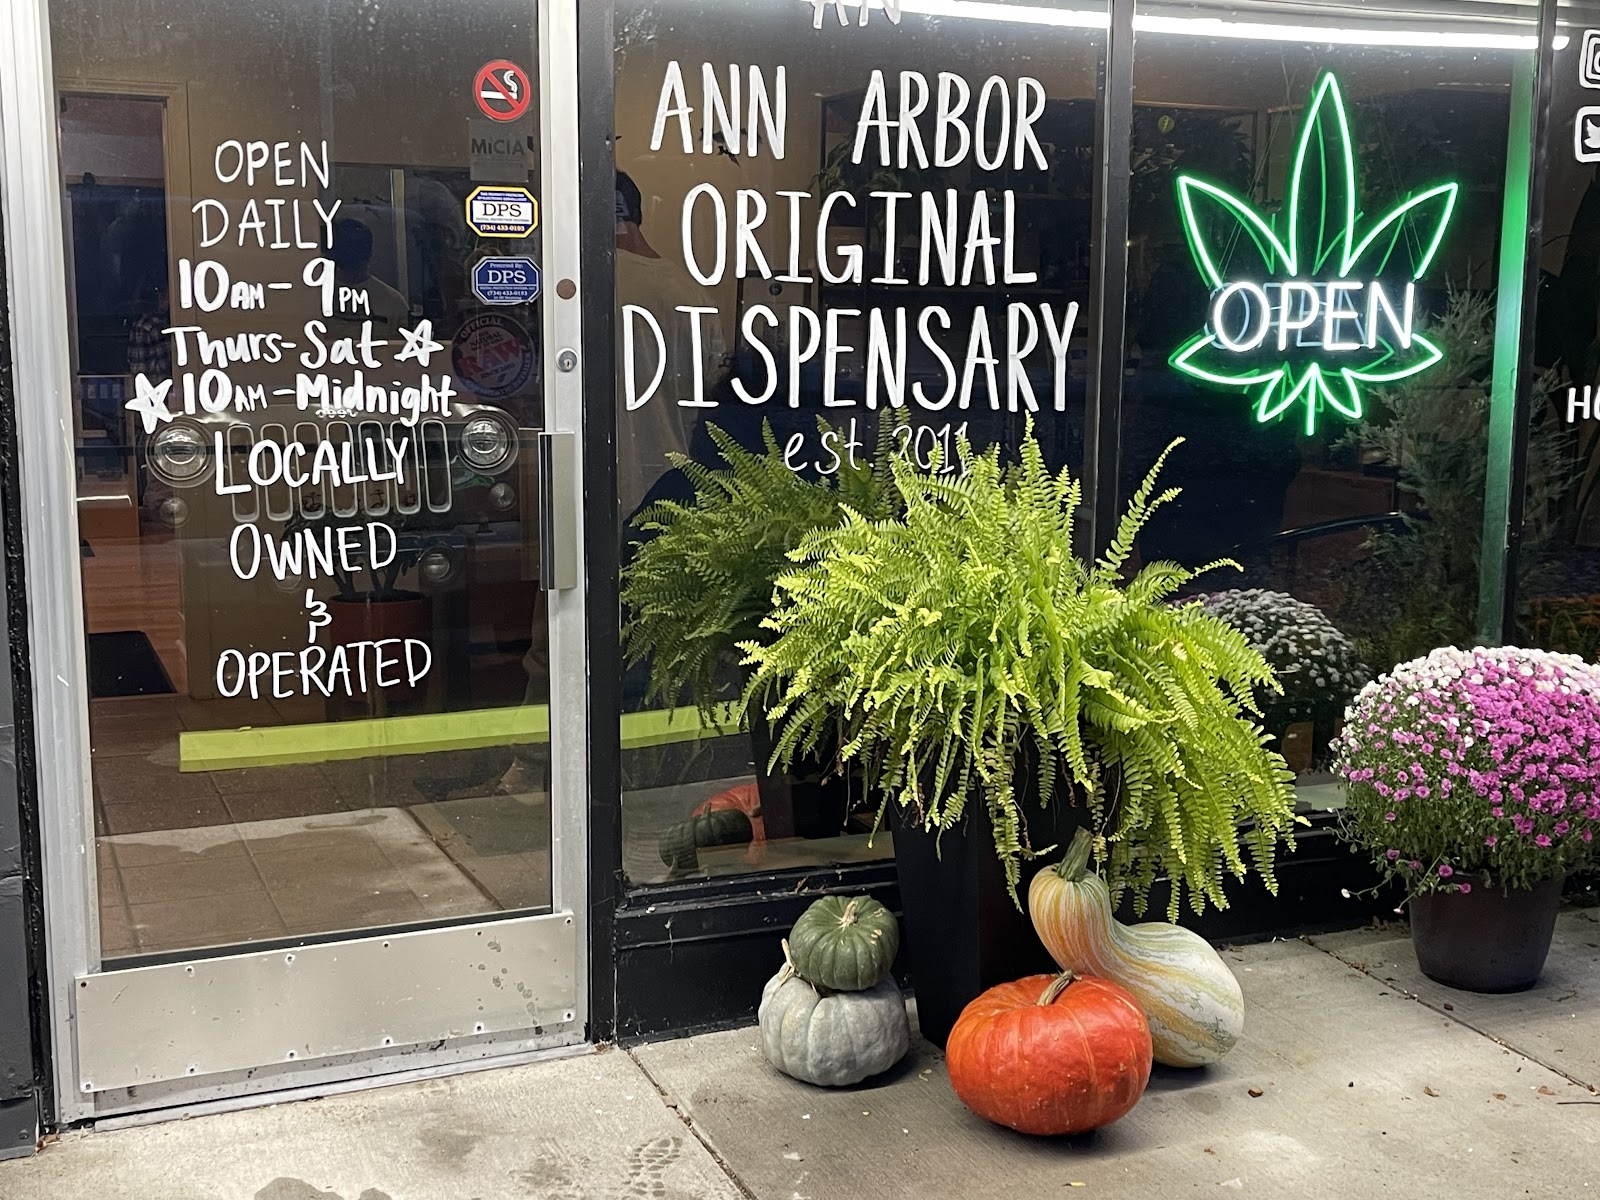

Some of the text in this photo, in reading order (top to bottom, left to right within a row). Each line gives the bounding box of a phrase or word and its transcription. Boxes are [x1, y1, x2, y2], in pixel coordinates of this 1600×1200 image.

[649, 60, 1049, 171] ANN ARBOR
[214, 140, 329, 189] OPEN
[191, 198, 342, 250] DAILY
[482, 203, 522, 217] DPS
[682, 182, 1038, 286] ORIGINAL
[487, 270, 527, 284] DPS
[461, 315, 504, 339] OFFICIAL
[1210, 279, 1417, 353] OPEN
[621, 301, 1079, 413] DISPENSARY
[214, 430, 410, 496] LOCALLY
[784, 417, 875, 475] est.
[229, 522, 397, 581] OWNED
[216, 637, 432, 700] OPERATED
